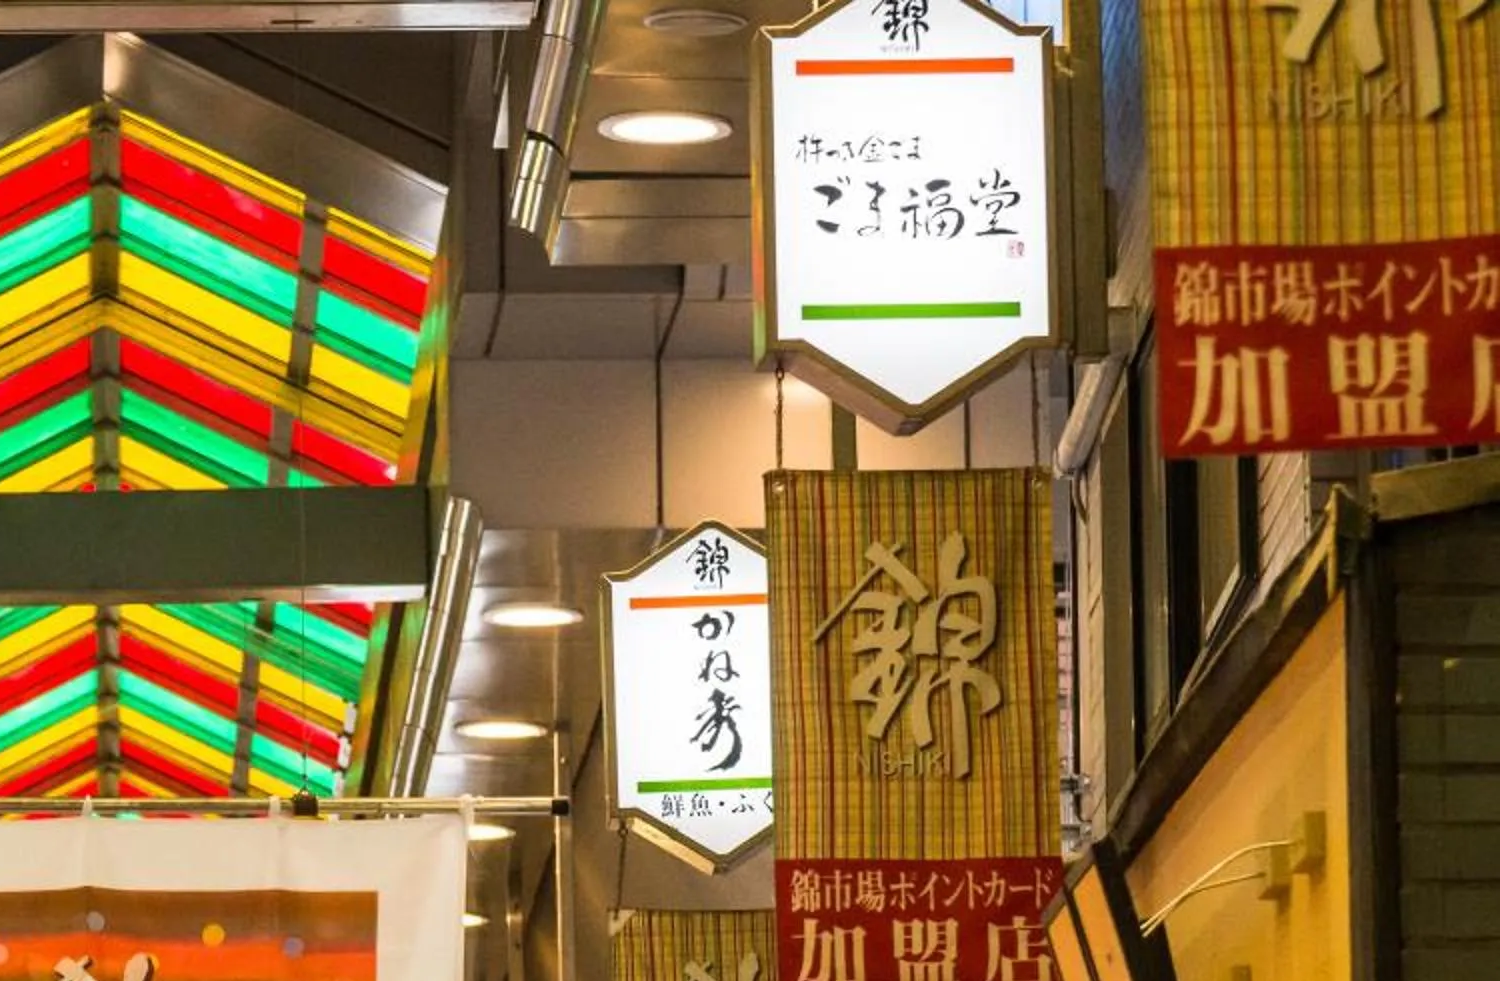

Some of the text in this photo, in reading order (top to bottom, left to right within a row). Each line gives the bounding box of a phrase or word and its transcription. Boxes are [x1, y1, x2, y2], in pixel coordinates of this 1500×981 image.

[871, 0, 929, 52] 錦
[813, 168, 1021, 240] ごま福堂
[1173, 253, 1500, 328] 錦市場ポイントカ
[685, 537, 730, 590] 錦
[813, 530, 1003, 779] 錦
[789, 868, 1054, 914] 錦市場ポイントカード
